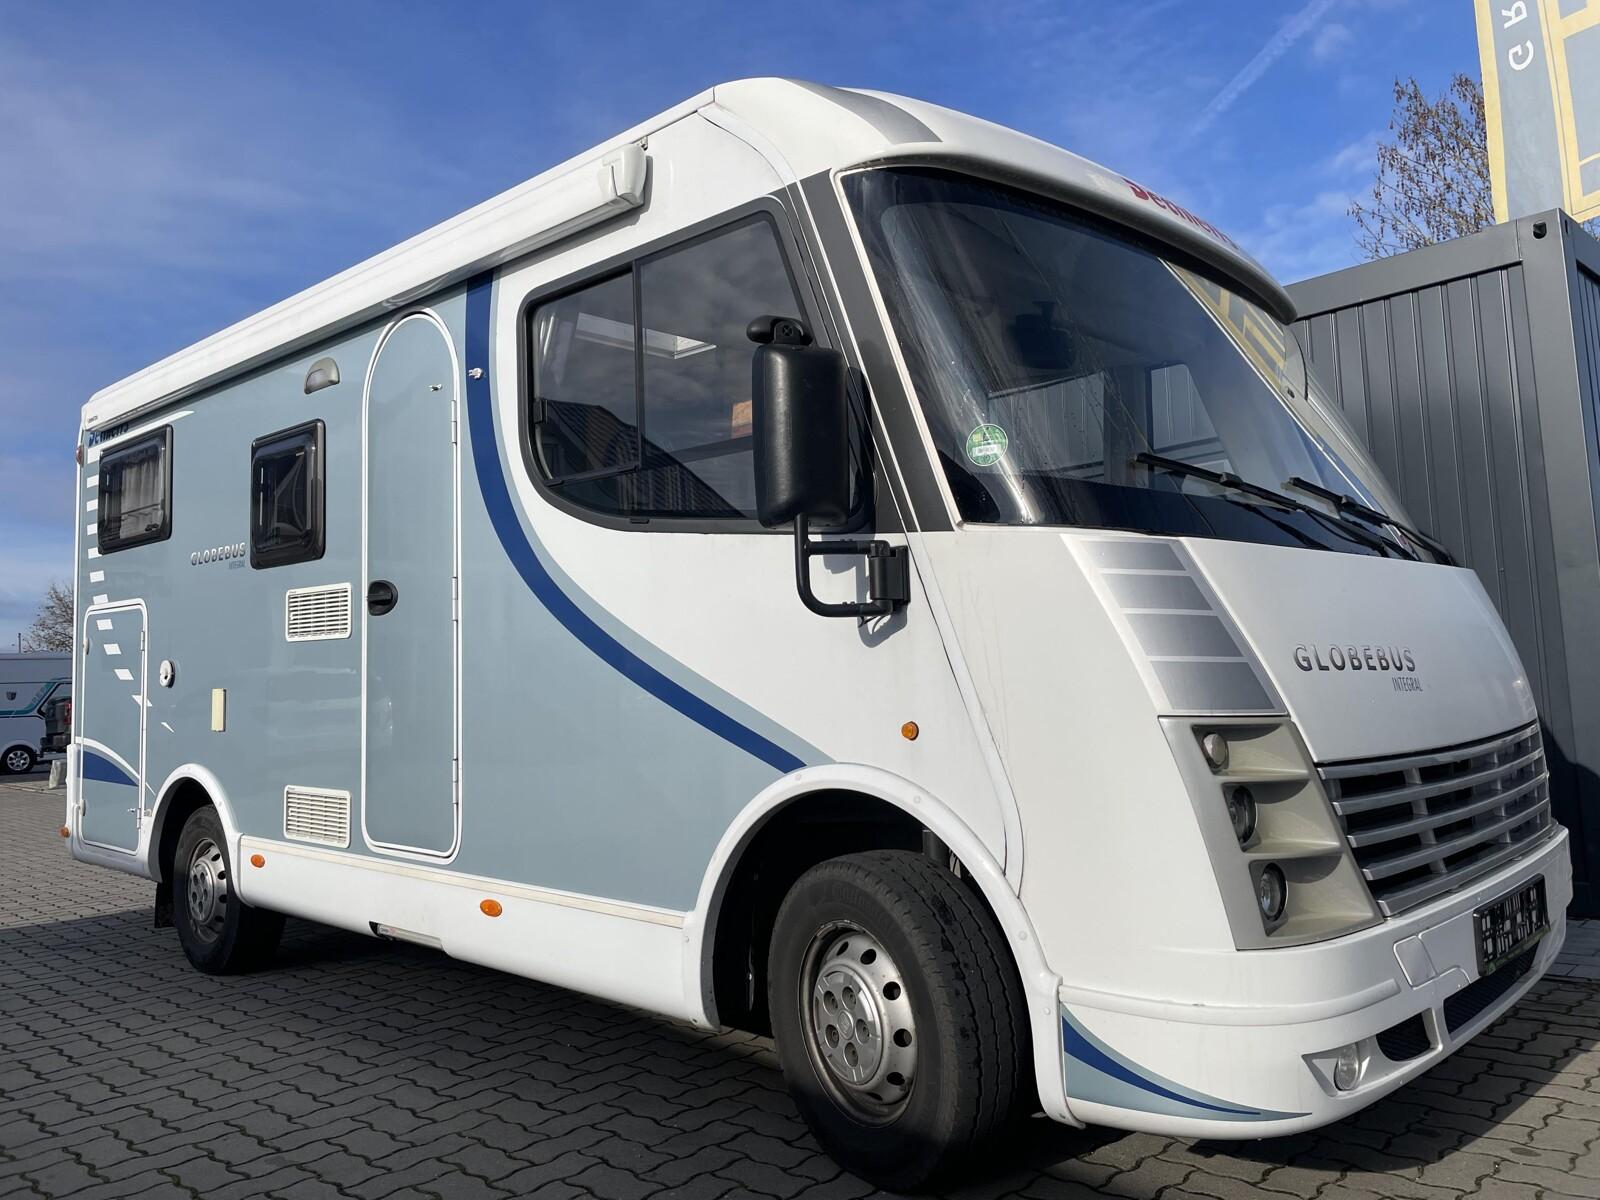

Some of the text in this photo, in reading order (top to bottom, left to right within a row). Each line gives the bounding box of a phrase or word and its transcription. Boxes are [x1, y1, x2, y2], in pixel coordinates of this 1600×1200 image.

[190, 542, 246, 566] GLOBEBUS
[1293, 644, 1416, 672] GLOBEBUS
[1391, 676, 1423, 692] INTEGRAL
